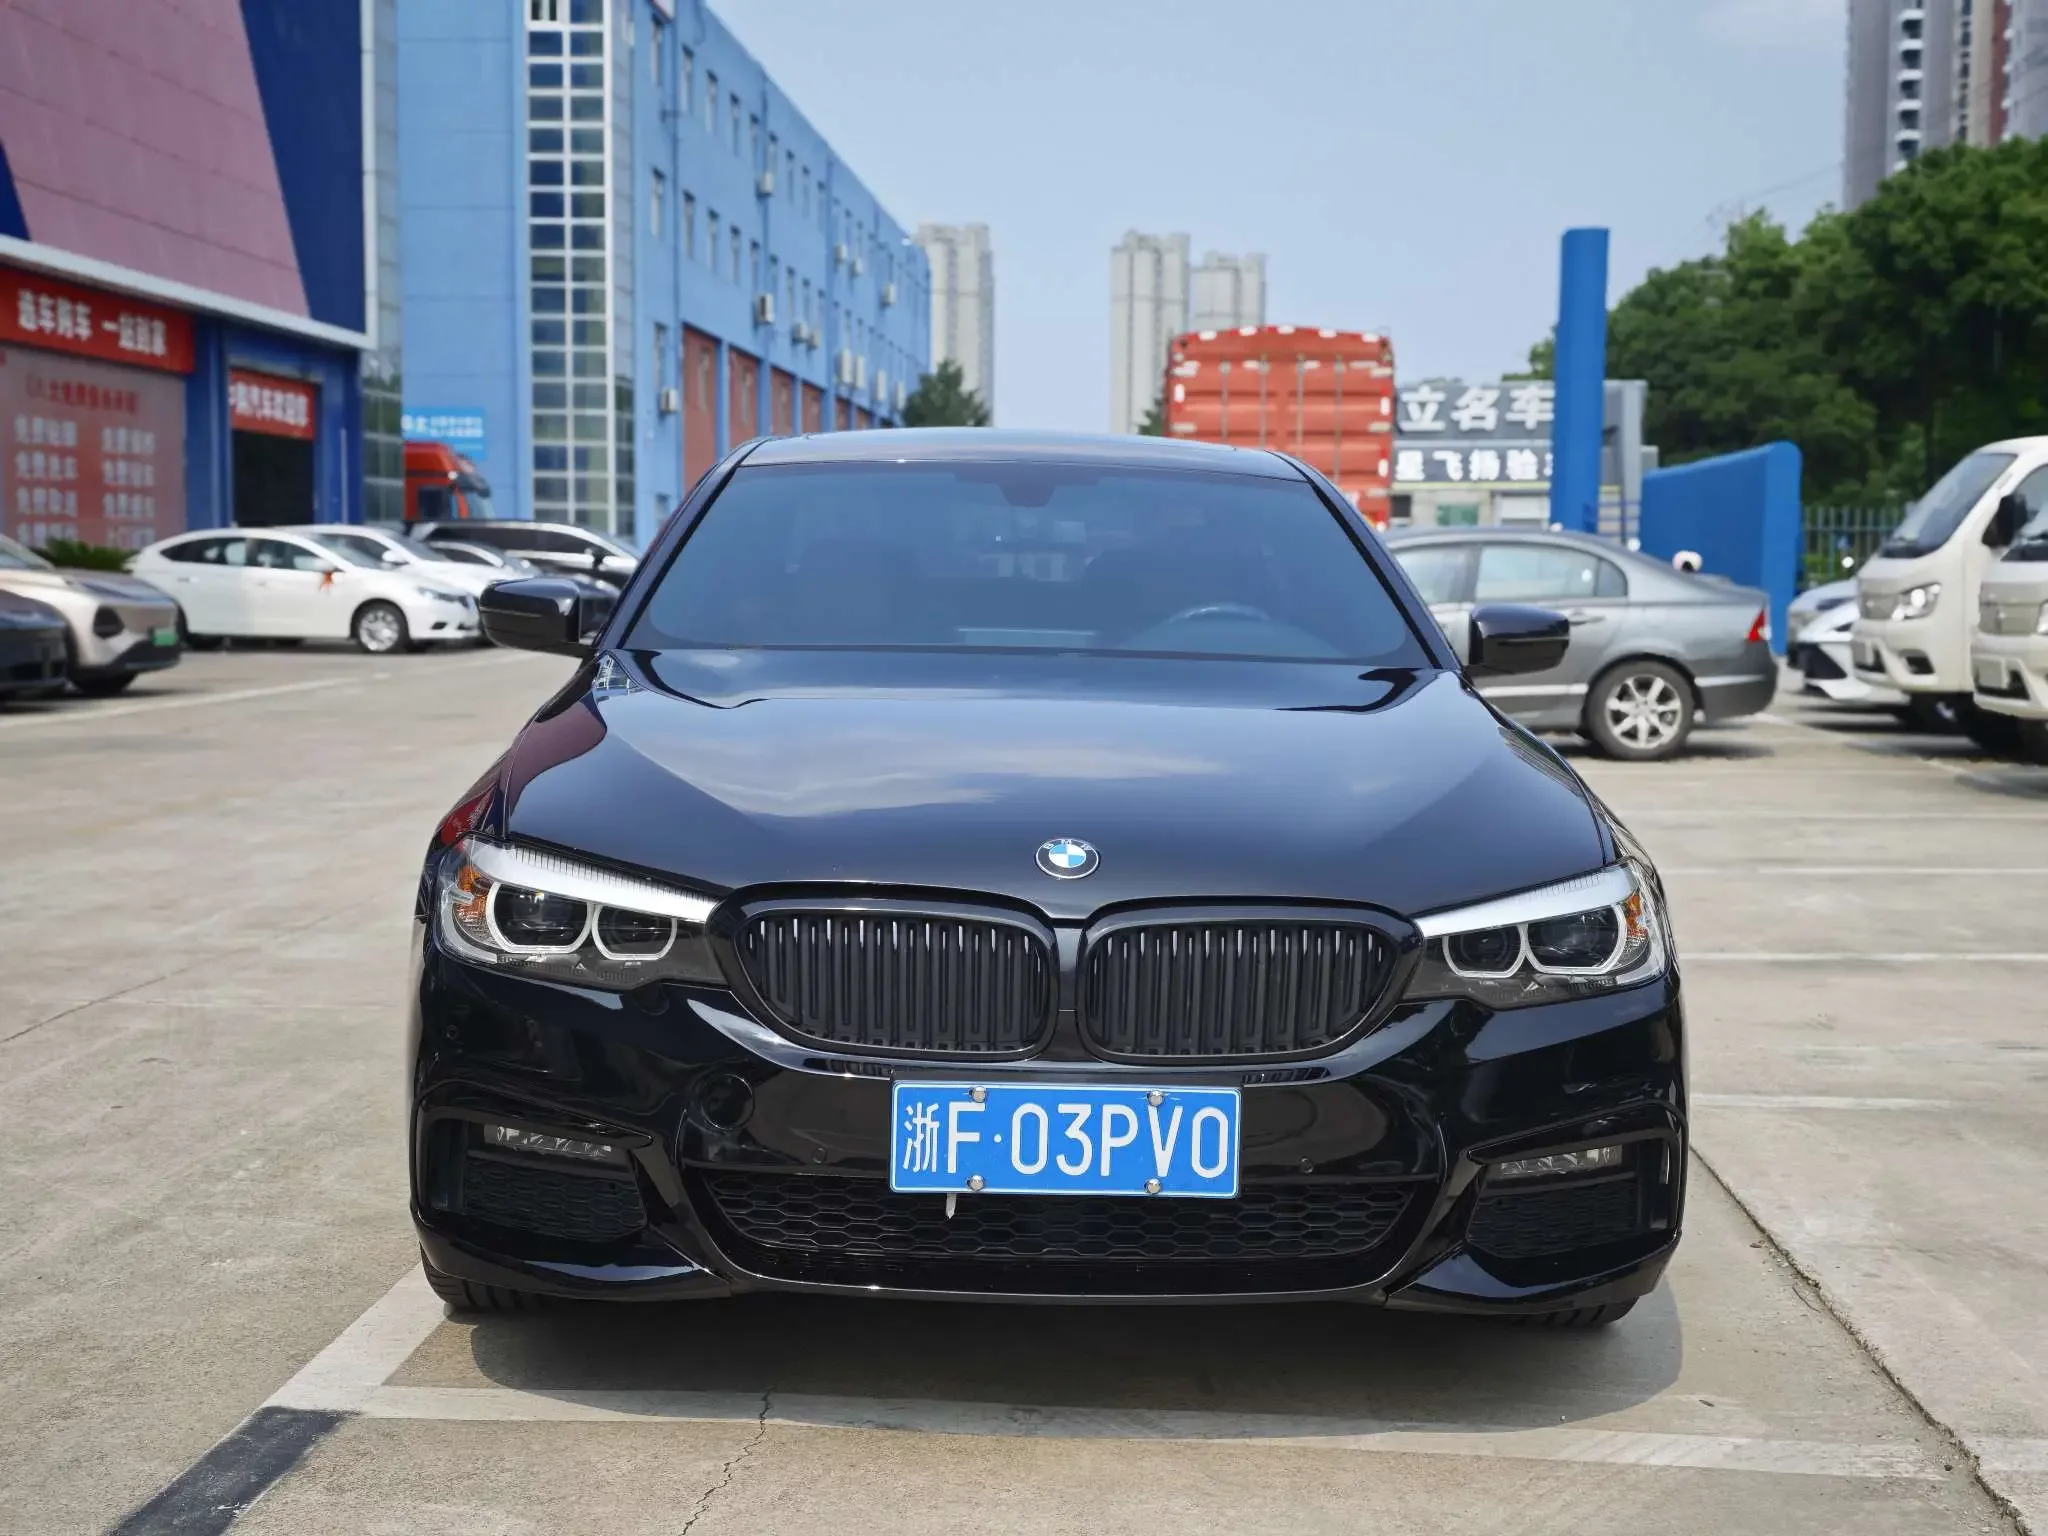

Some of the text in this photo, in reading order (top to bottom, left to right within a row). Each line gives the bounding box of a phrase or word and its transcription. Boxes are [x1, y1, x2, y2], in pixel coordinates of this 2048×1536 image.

[1399, 385, 1555, 431] 立名车
[1396, 448, 1553, 481] 星飞扬验
